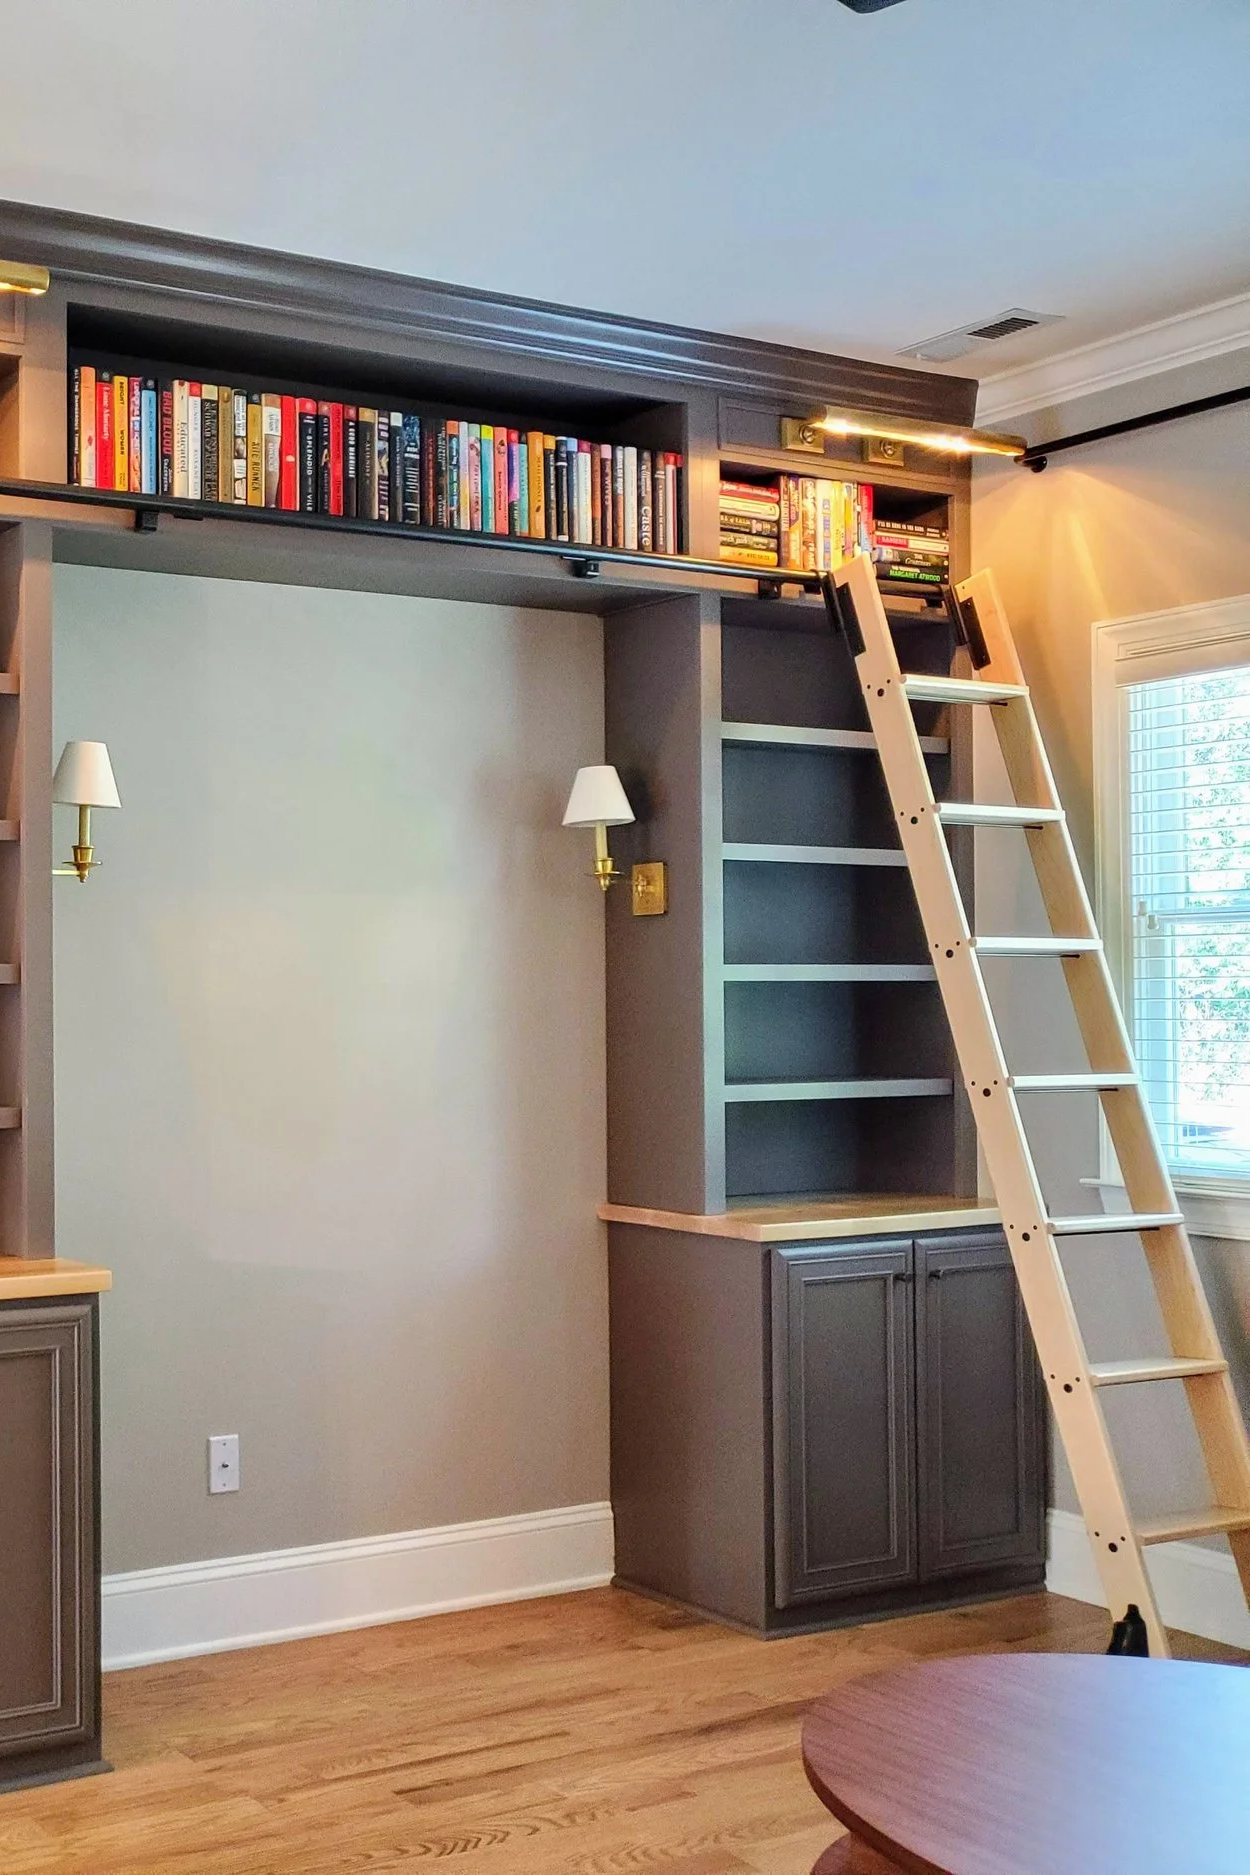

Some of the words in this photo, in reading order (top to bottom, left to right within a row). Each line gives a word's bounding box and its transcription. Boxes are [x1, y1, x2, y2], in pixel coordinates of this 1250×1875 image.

[102, 387, 110, 408] Liane
[163, 391, 172, 414] BAD
[102, 408, 110, 440] Moriarty
[163, 417, 172, 455] BLOOD
[180, 422, 188, 473] Educated
[252, 462, 260, 492] RUNNER
[642, 506, 651, 545] Caste
[890, 570, 918, 578] MARGARET
[918, 572, 940, 582] ATWOOD
